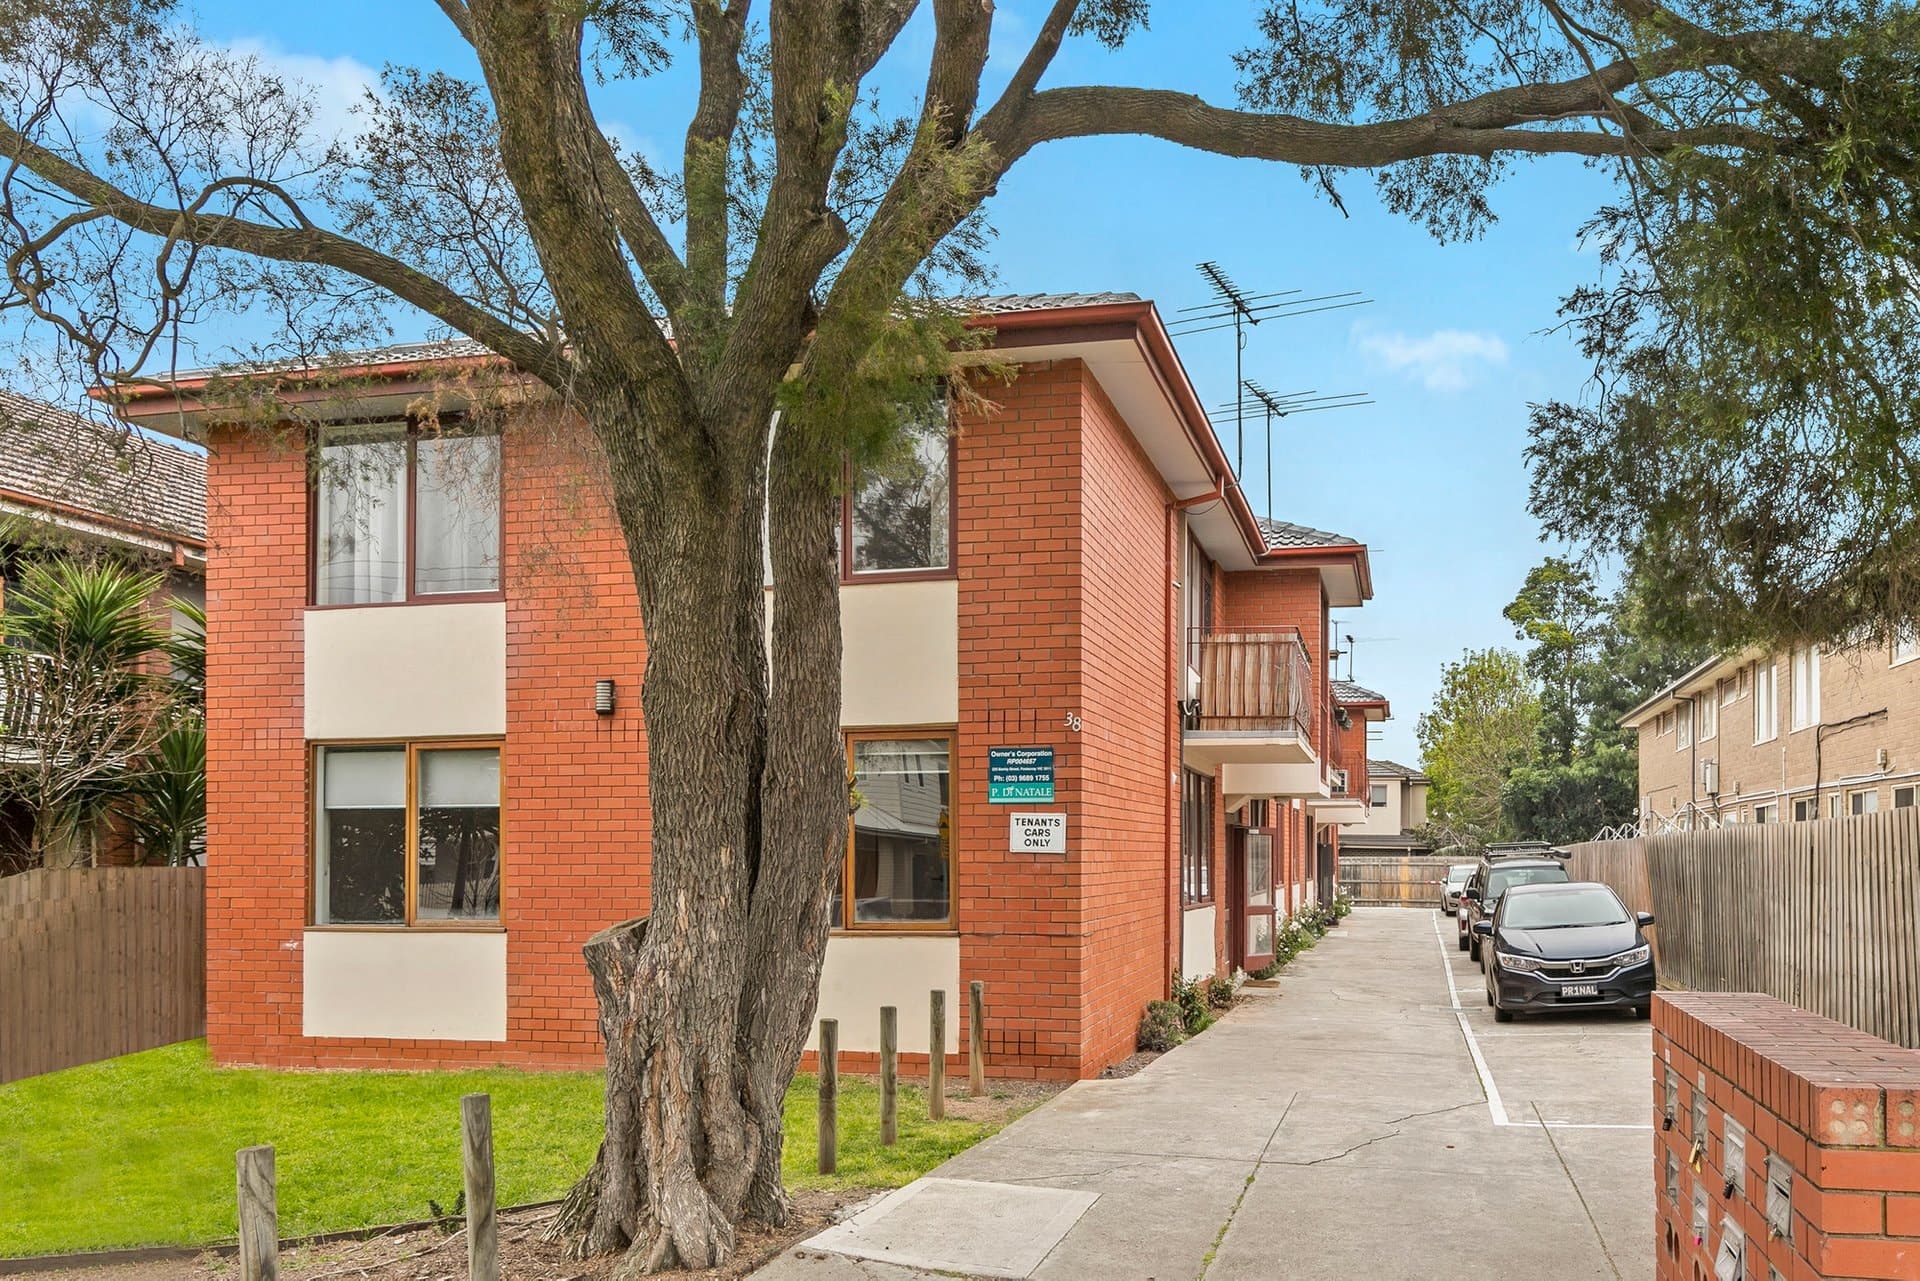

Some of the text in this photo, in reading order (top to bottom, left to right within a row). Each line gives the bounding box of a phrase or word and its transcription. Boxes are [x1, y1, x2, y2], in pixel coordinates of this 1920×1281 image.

[1063, 711, 1082, 732] 38
[990, 750, 1053, 759] Owner's Corporation
[1005, 775, 1018, 783] (03)
[991, 787, 1000, 797] P.
[1014, 787, 1052, 797] NATALE
[1014, 817, 1061, 828] TENANTS
[1024, 828, 1051, 838] CARS
[1024, 838, 1051, 848] ONLY
